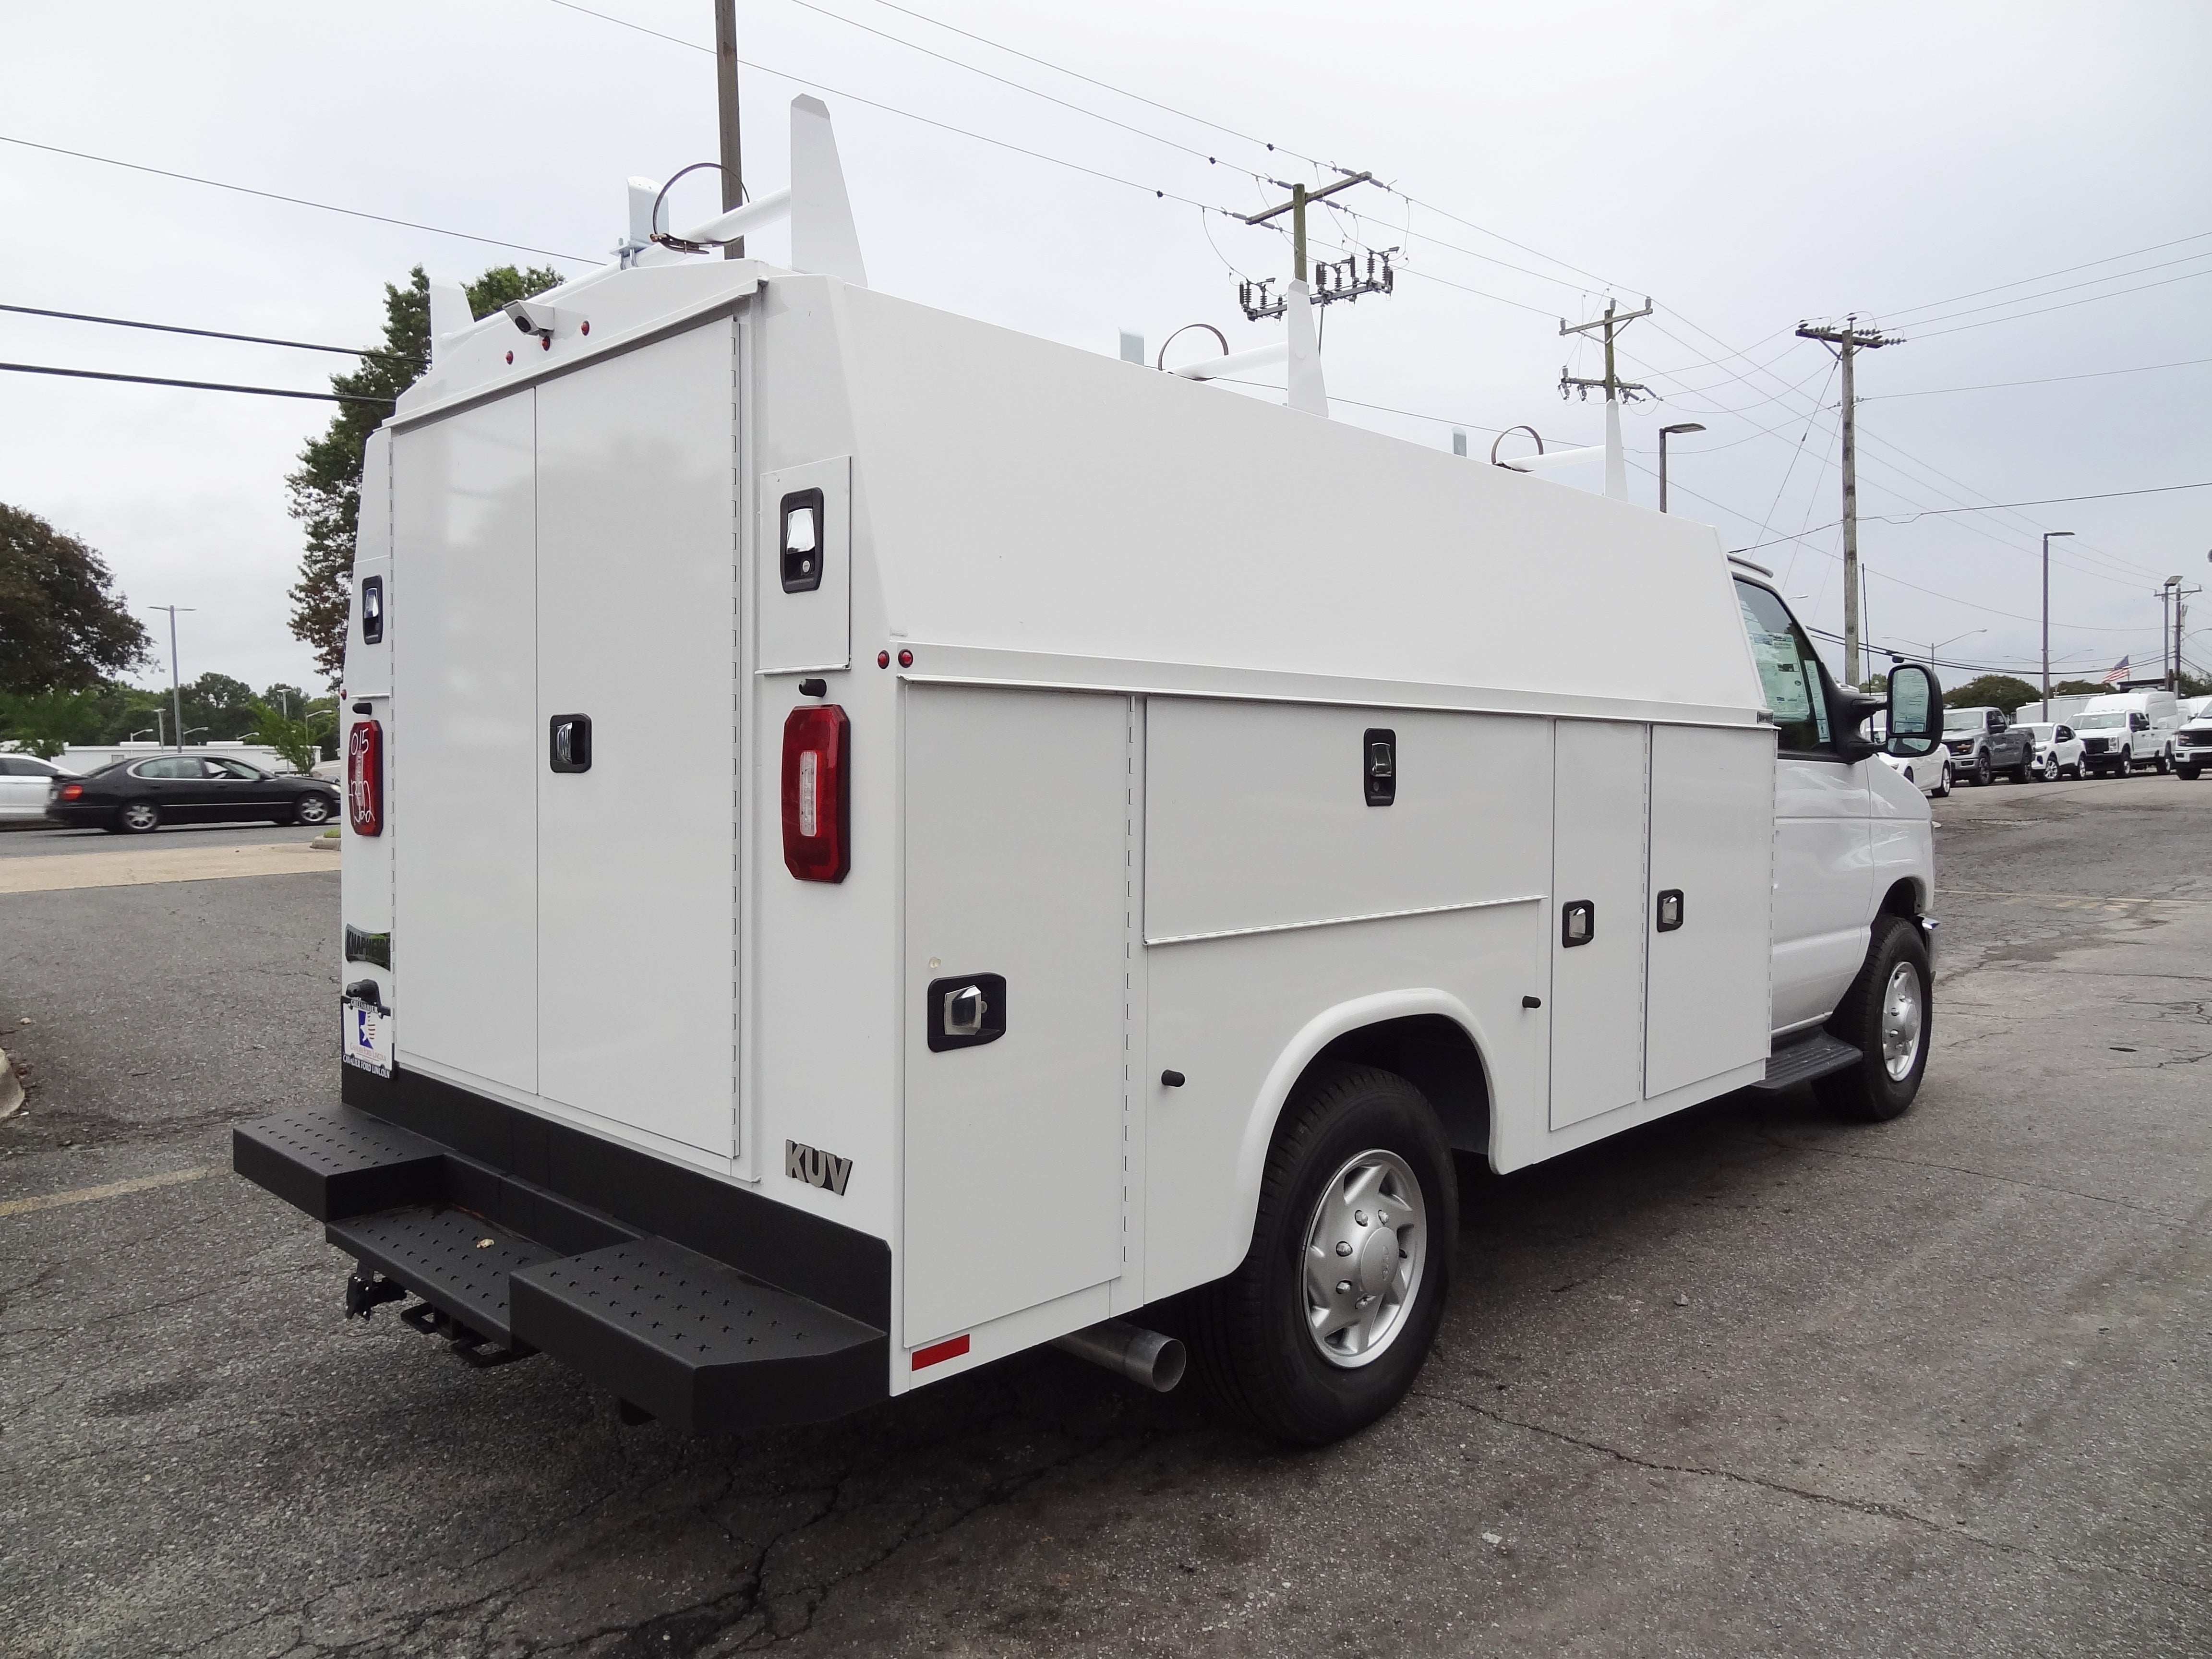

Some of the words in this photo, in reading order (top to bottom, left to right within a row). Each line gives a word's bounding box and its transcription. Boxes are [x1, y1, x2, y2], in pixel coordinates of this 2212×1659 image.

[351, 728, 369, 756] 015
[343, 1054, 361, 1068] CAVALIER
[361, 1060, 371, 1072] FORD
[372, 1065, 390, 1079] LINCOLN
[786, 1139, 853, 1196] KUV
